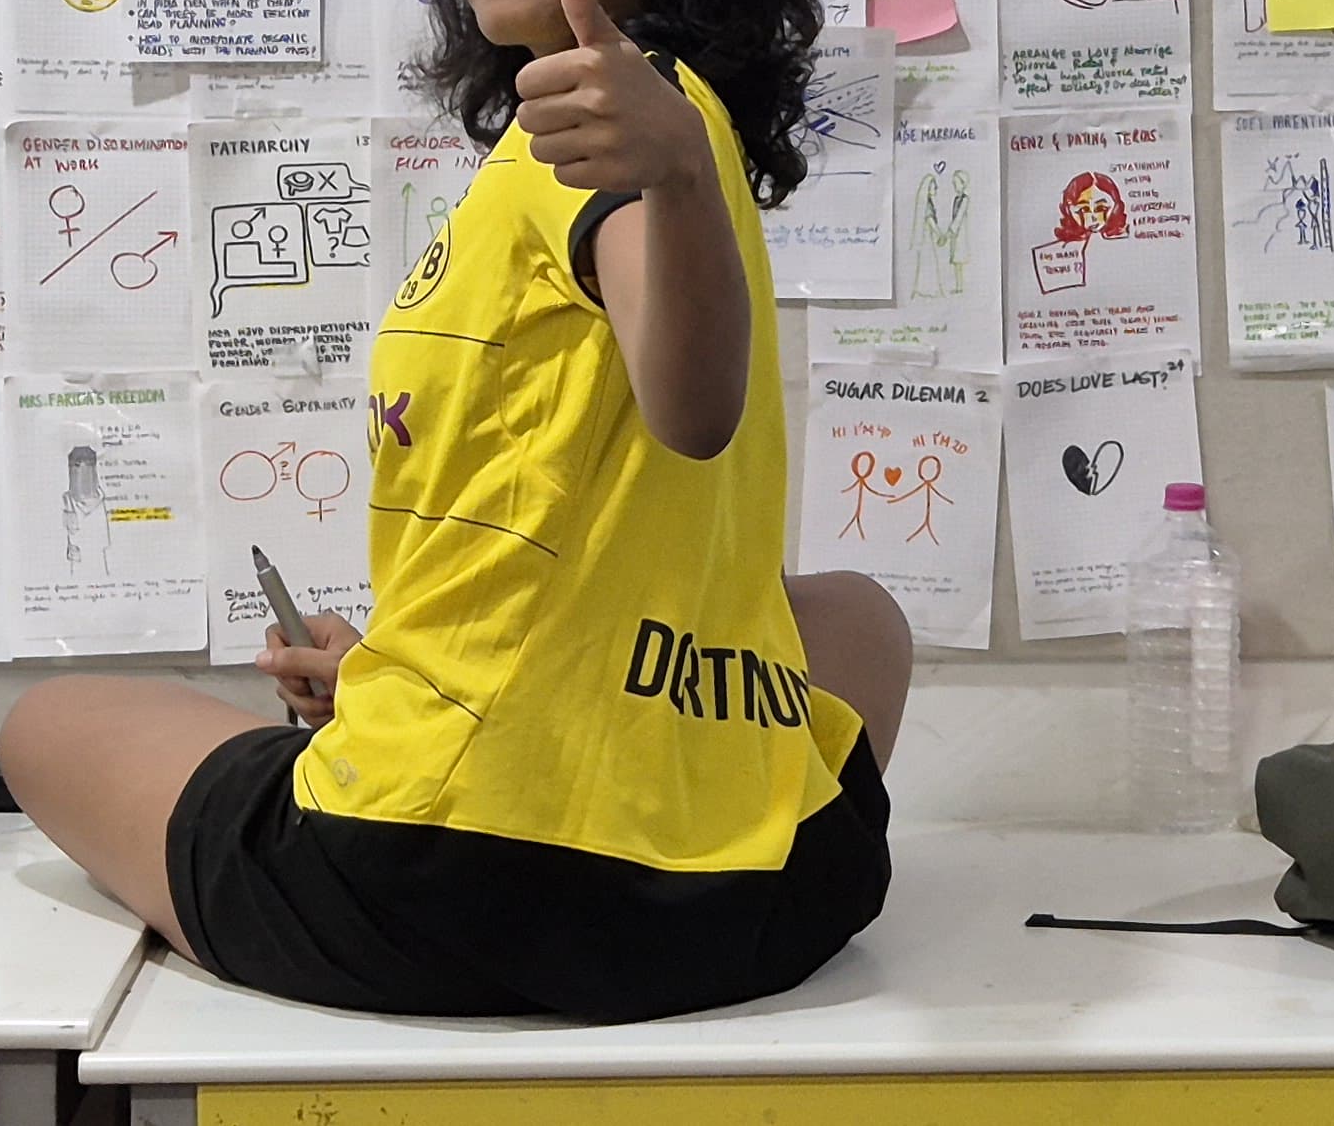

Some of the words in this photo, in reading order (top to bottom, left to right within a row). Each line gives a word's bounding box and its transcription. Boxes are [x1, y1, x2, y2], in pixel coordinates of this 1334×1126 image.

[210, 138, 310, 157] PATRIARCHY
[825, 379, 885, 401] SUGAR
[891, 382, 966, 404] DILEMMA
[1016, 378, 1067, 399] DOES
[1070, 372, 1116, 393] LOVE
[1121, 370, 1169, 389] LAST?
